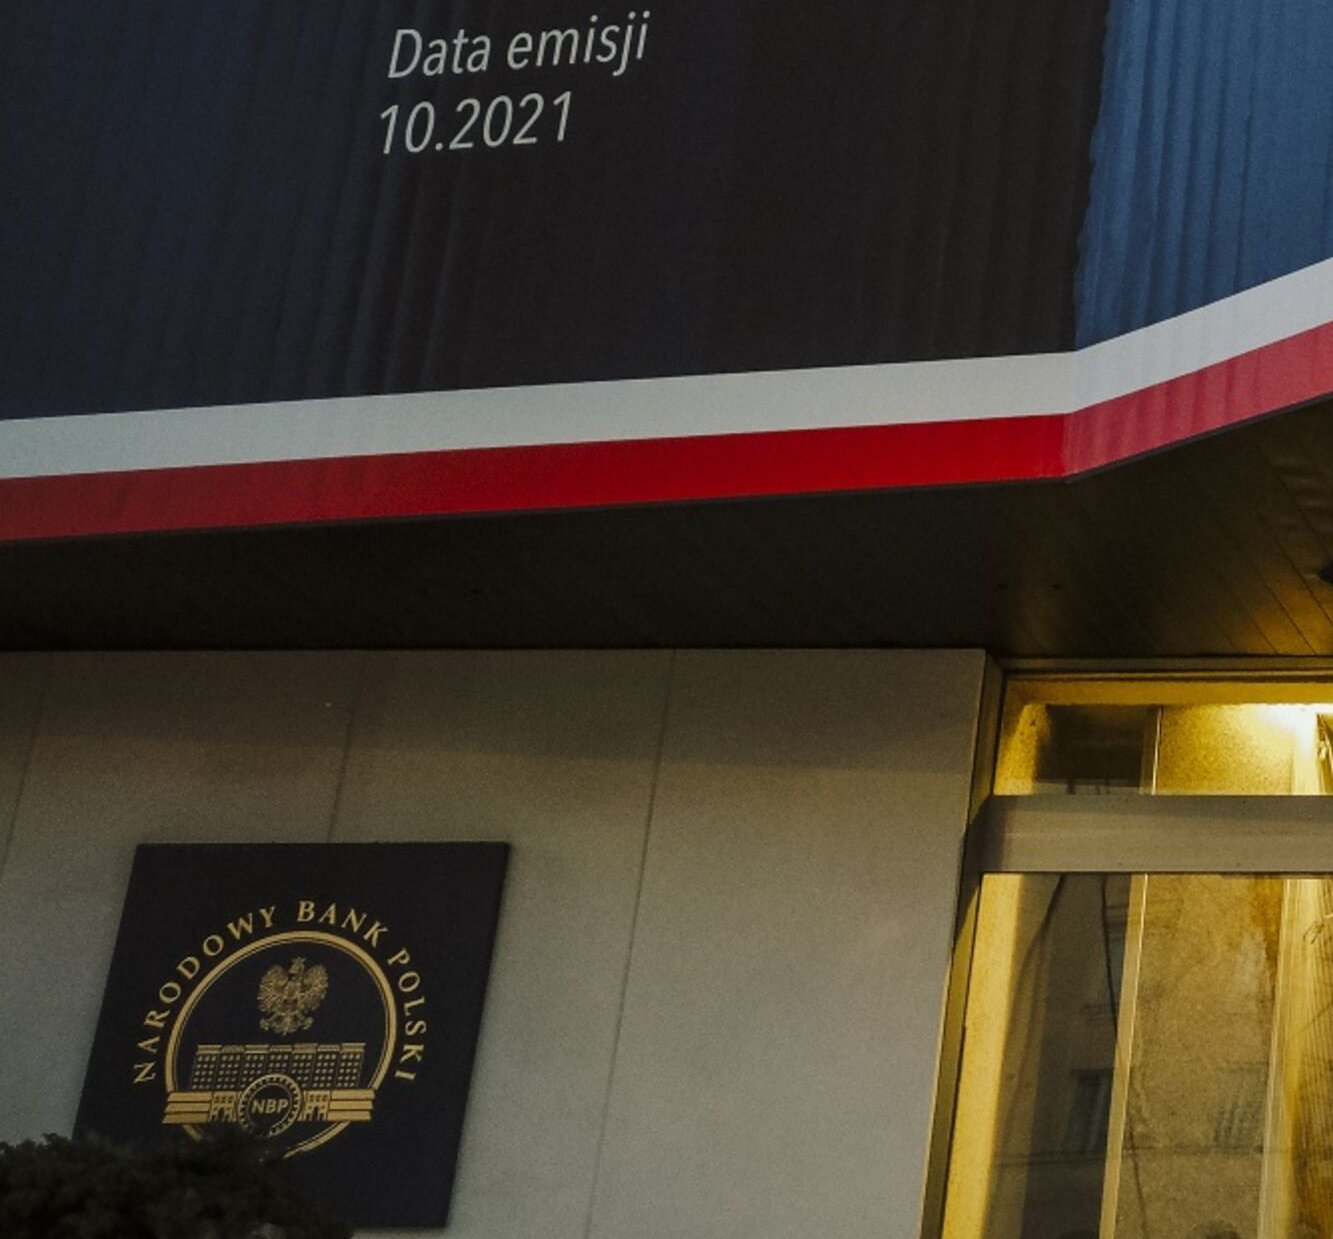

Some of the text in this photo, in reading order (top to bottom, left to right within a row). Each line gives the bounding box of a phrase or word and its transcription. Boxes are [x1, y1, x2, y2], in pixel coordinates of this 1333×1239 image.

[387, 11, 650, 79] Data emisji
[379, 91, 572, 155] 10.2021
[133, 899, 428, 1086] NARODOWY BANK POLSKI
[251, 1098, 289, 1115] NBP
